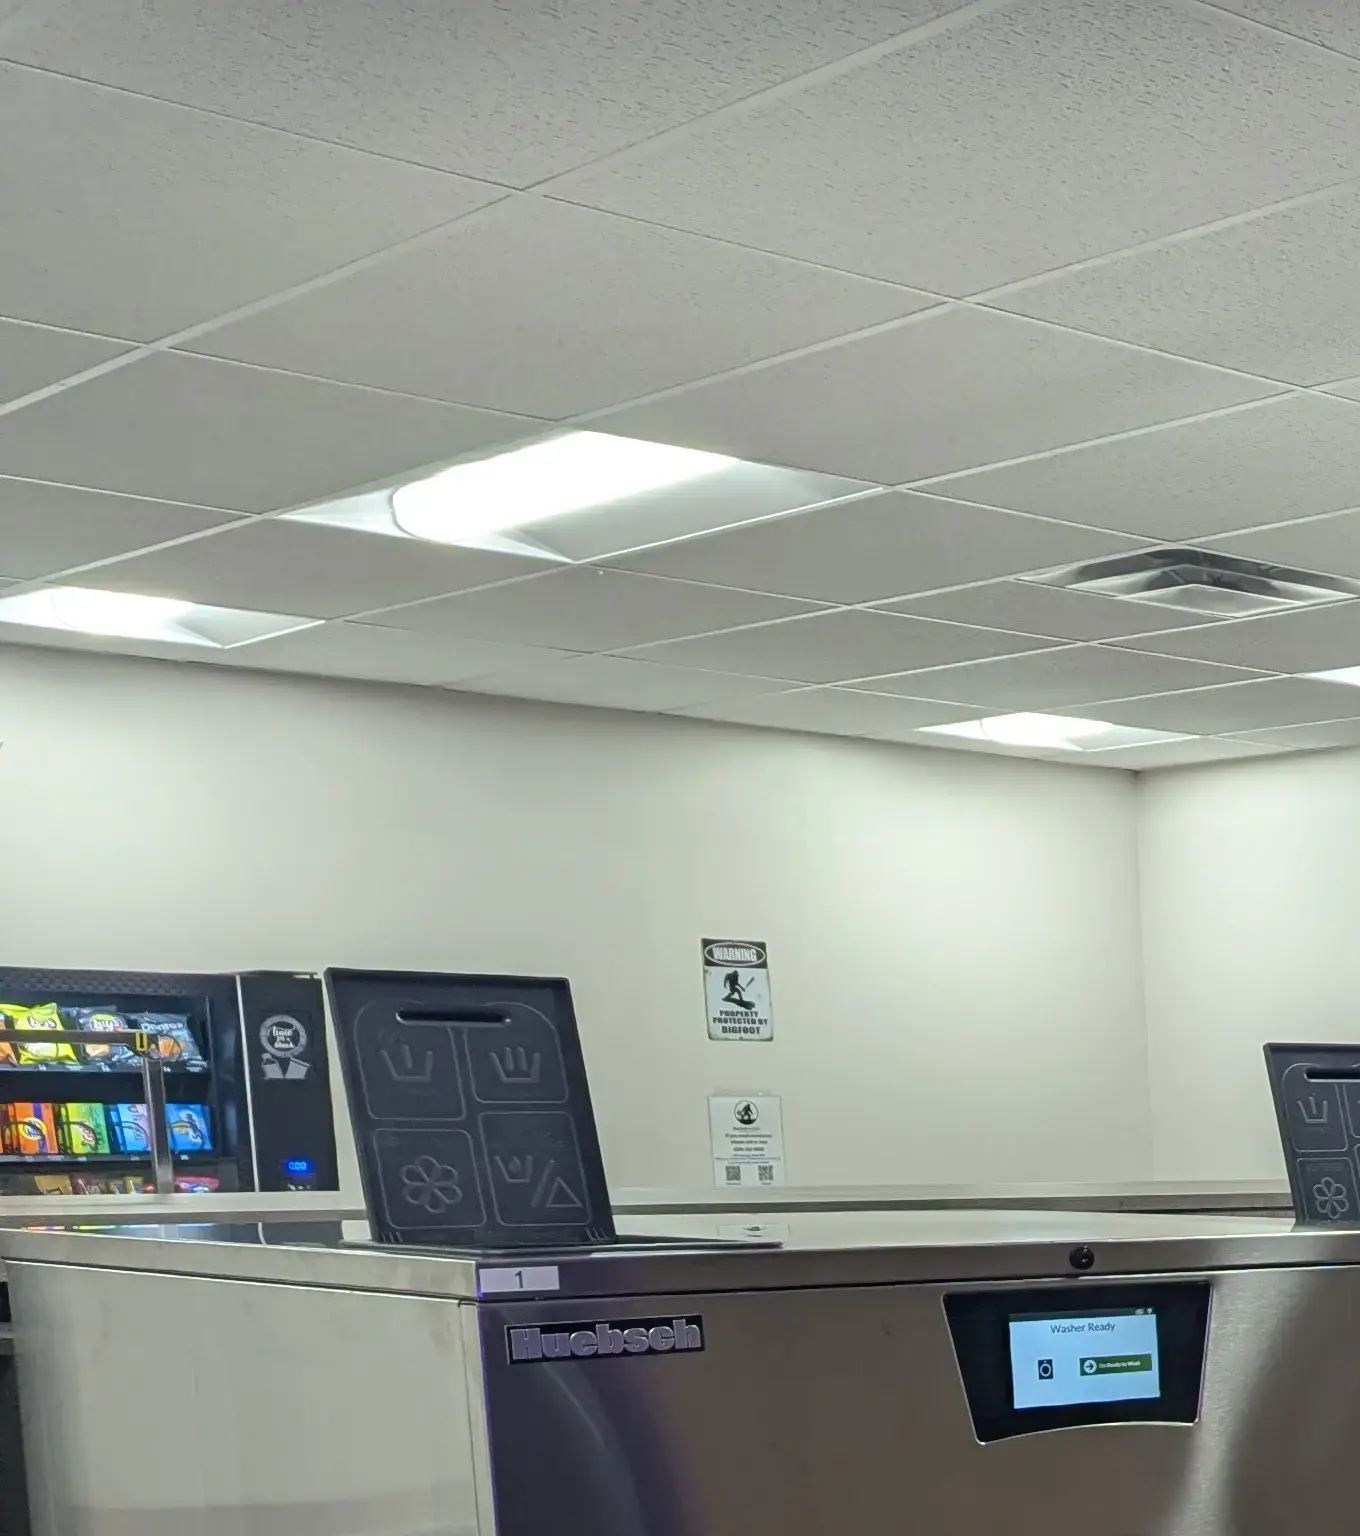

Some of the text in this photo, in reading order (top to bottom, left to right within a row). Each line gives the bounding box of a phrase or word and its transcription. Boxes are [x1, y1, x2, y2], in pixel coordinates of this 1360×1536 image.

[712, 947, 758, 961] WARNING
[719, 1010, 759, 1018] PROPERTY
[712, 1017, 757, 1025] PROTECTED
[721, 1025, 761, 1035] BIGFOOT
[514, 1270, 524, 1289] 1
[1050, 1321, 1116, 1334] Washer Ready
[510, 1319, 702, 1360] Huebsch
